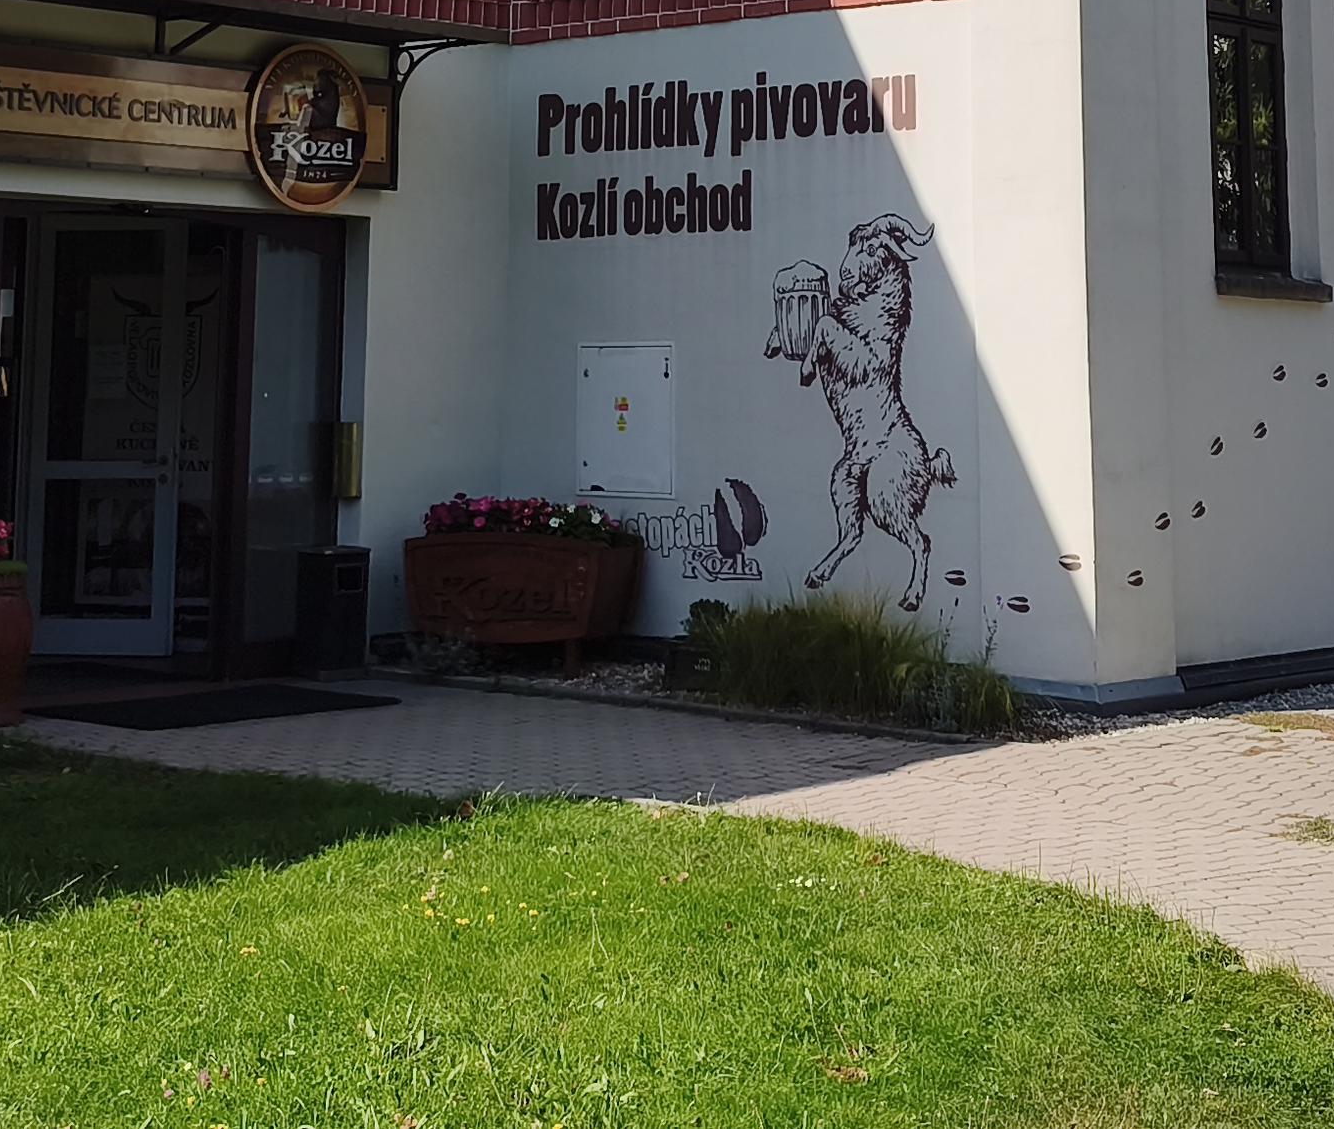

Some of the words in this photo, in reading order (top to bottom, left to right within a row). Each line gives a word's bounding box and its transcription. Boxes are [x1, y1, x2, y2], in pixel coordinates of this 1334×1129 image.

[128, 99, 237, 131] CENTRUM
[537, 79, 724, 158] Prohlídky
[730, 71, 917, 158] pivovaru
[267, 131, 354, 166] Kozel
[303, 170, 328, 179] 1874
[536, 176, 620, 241] Kozlí
[623, 169, 753, 236] obchod
[683, 549, 761, 582] Kozla
